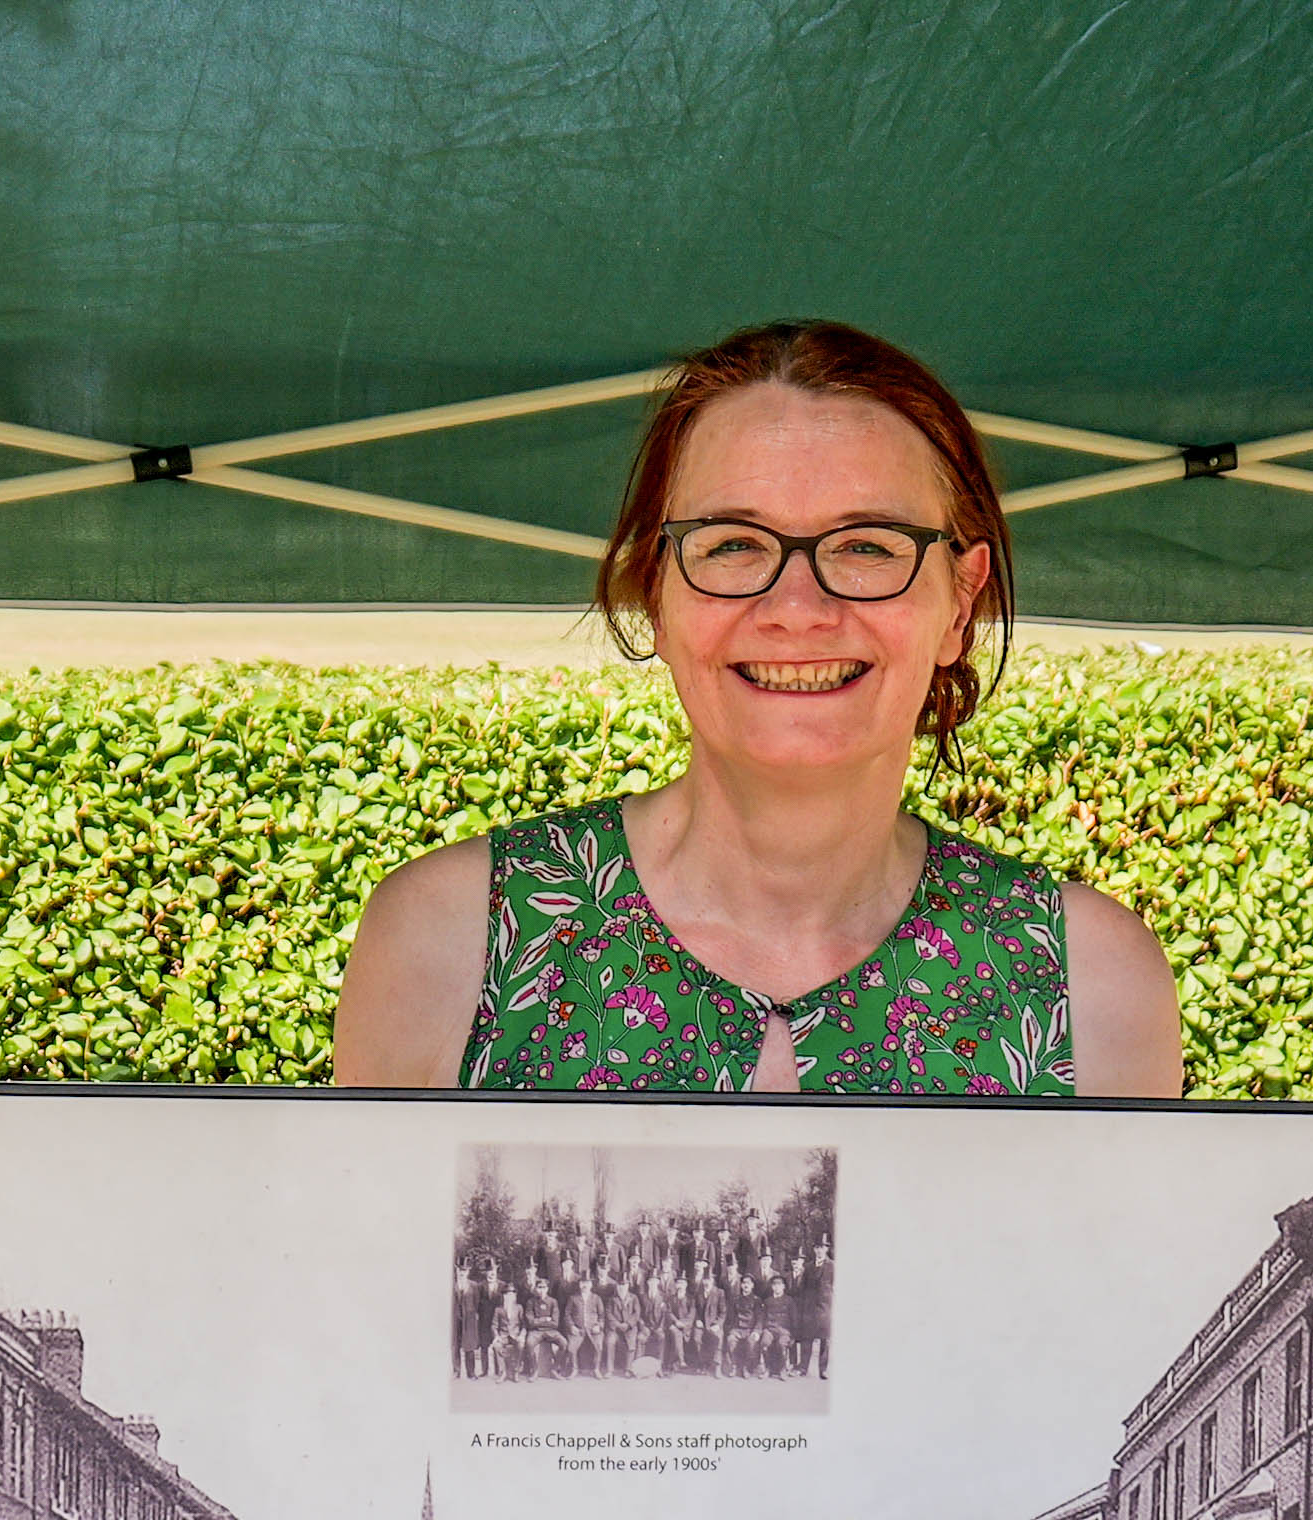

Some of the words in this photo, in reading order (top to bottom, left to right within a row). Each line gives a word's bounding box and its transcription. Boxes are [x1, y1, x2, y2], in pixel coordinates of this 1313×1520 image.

[471, 1433, 482, 1447] A
[487, 1433, 541, 1448] Francis
[545, 1433, 615, 1452] Chappell
[619, 1433, 631, 1448] &
[635, 1433, 672, 1448] Sons
[677, 1433, 711, 1448] staff
[714, 1434, 807, 1452] photograph
[558, 1455, 595, 1471] from
[600, 1456, 626, 1471] the
[629, 1456, 667, 1474] early
